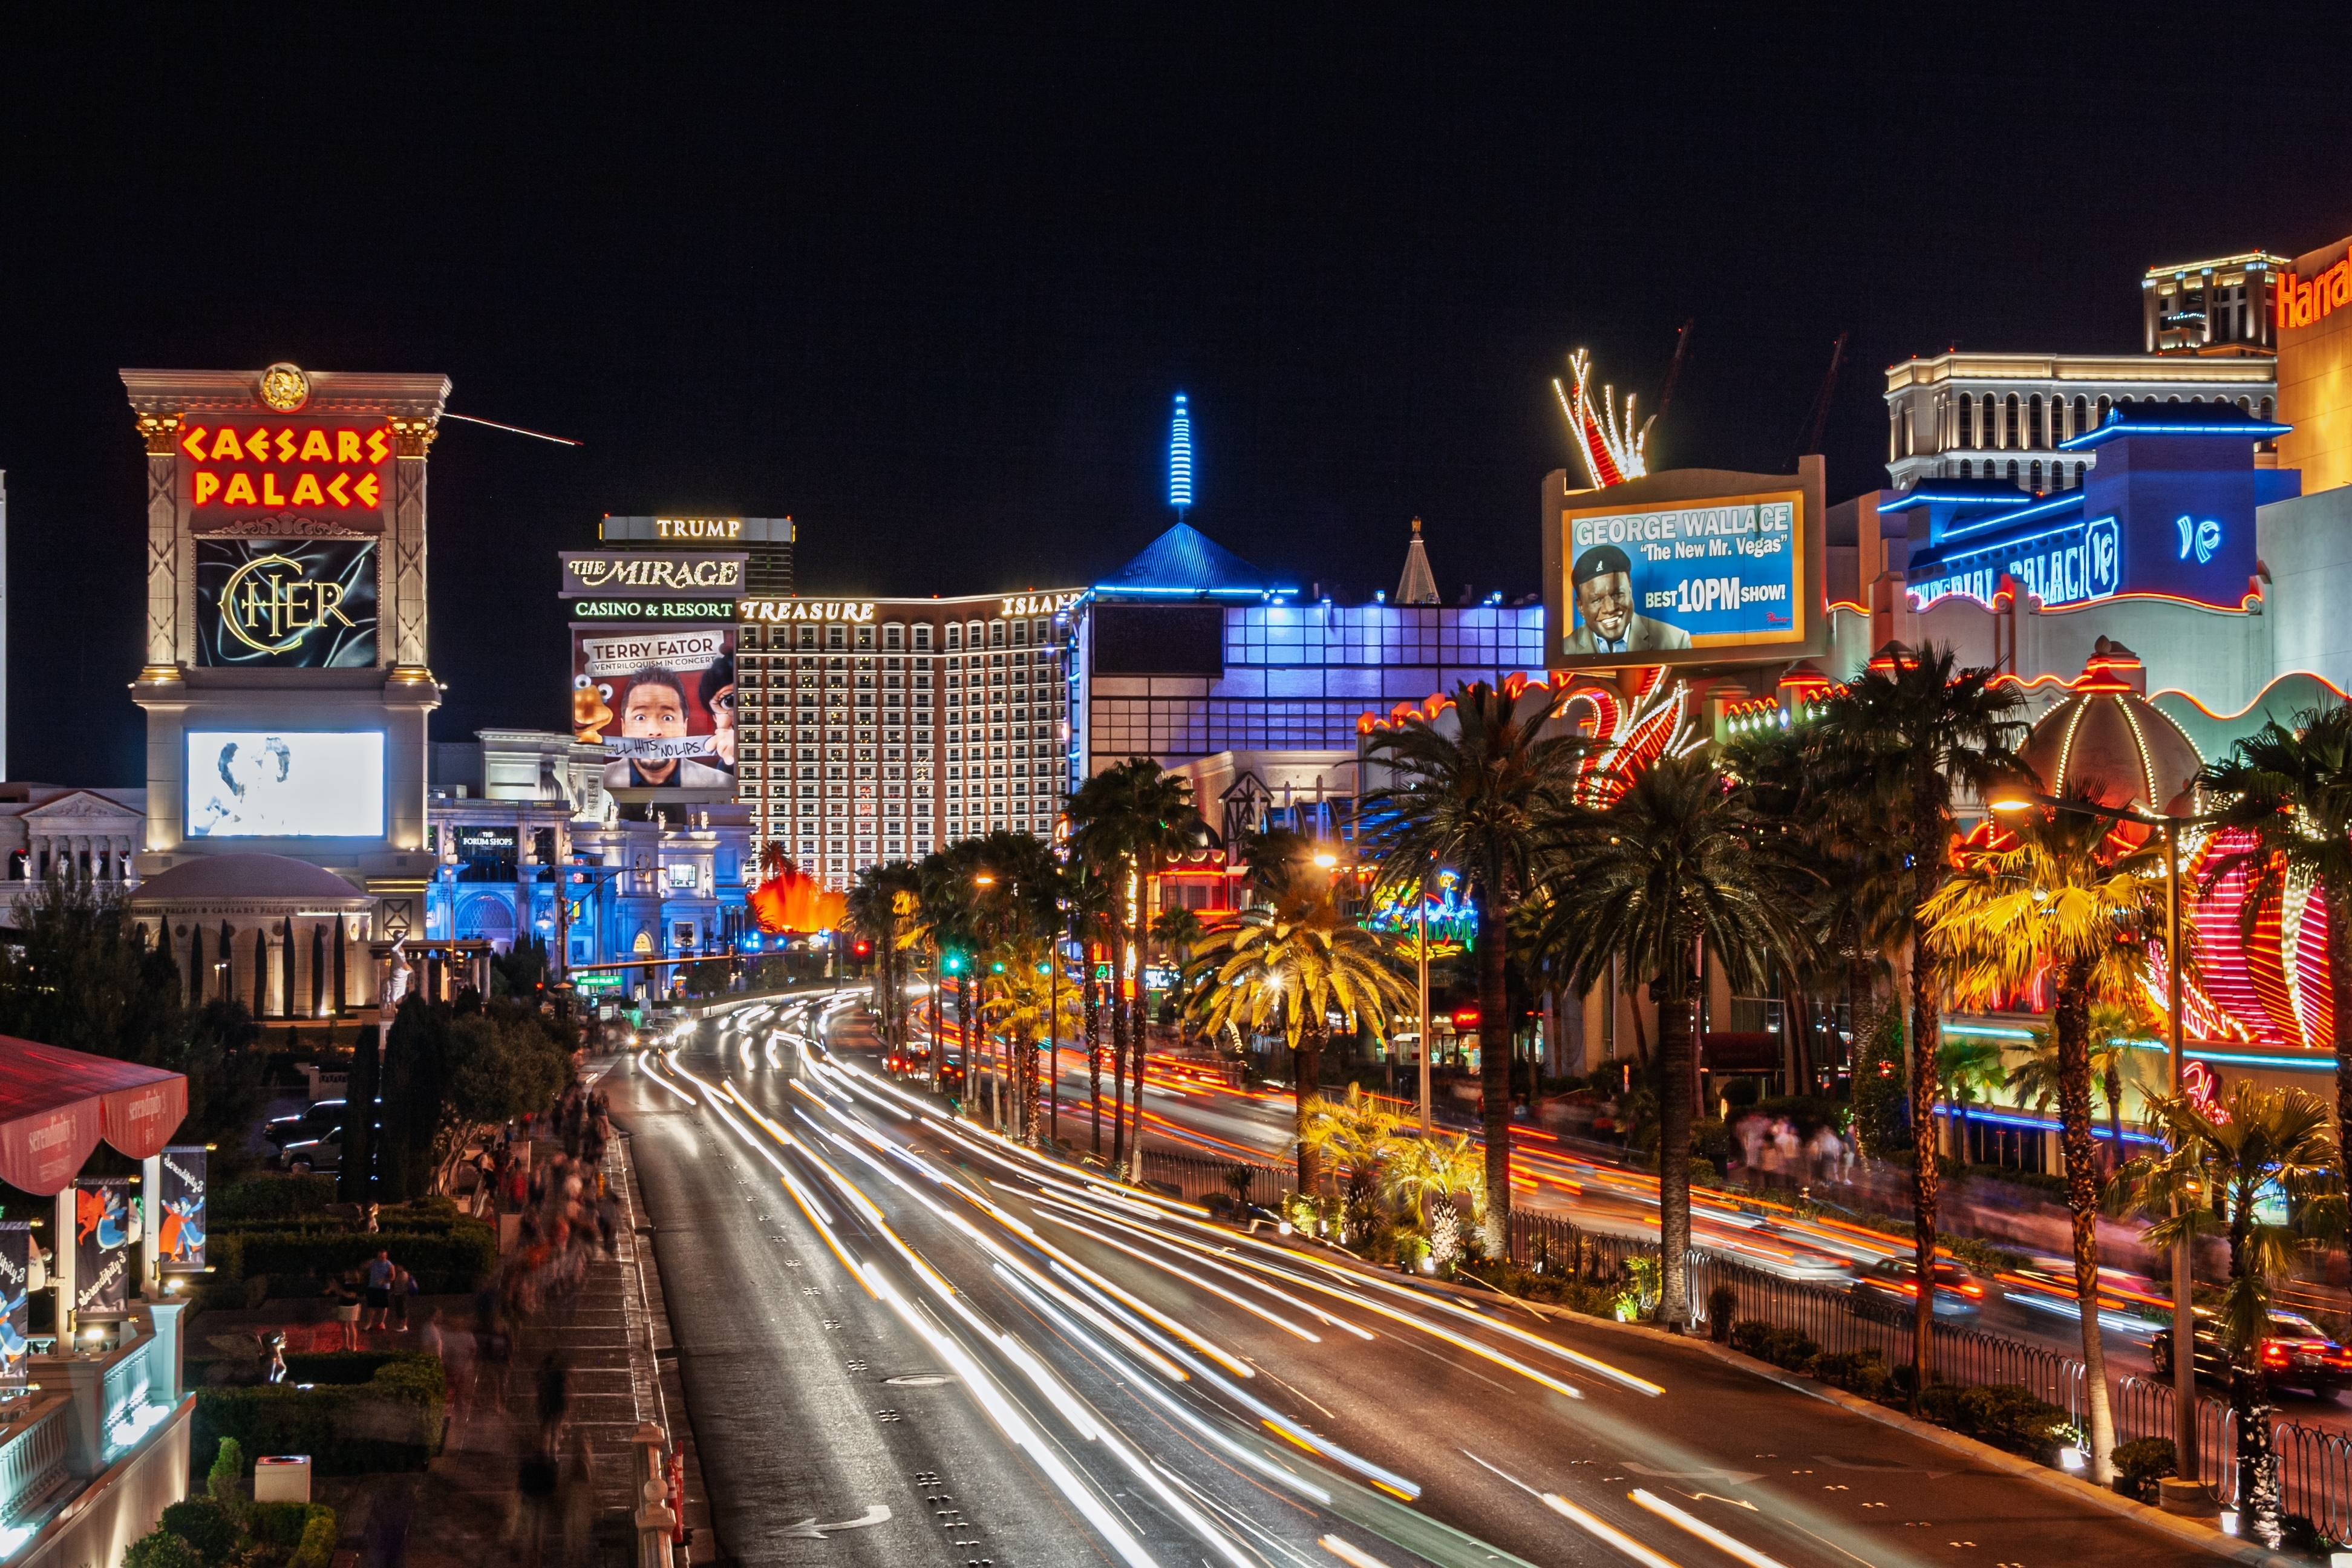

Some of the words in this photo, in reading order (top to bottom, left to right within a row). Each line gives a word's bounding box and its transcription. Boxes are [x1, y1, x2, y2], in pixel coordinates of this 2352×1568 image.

[183, 427, 388, 463] CAESARS
[195, 472, 380, 508] PALACE
[657, 520, 740, 538] TRUMP
[1576, 515, 1676, 546] GEORGE
[1684, 506, 1788, 537] WALLACE
[1675, 540, 1704, 558] New
[1708, 539, 1732, 557] Mr.
[569, 560, 606, 575] THE
[583, 561, 739, 589] MIRAGE
[217, 554, 355, 655] CHER
[1645, 590, 1677, 609] BEST
[1677, 577, 1740, 613] 10PM
[1741, 584, 1785, 603] SHOW!
[575, 603, 641, 617] CASINO
[645, 604, 659, 616] &
[662, 603, 733, 618] RESORT
[740, 601, 875, 622] TREASURE
[593, 642, 652, 659] TERRY
[658, 639, 714, 656] FATOR
[595, 659, 663, 671] VENTRILOQUISM
[675, 656, 716, 666] CONCERT
[635, 739, 660, 754] HITS.
[661, 745, 673, 757] NO
[675, 742, 703, 755] LIPS.
[117, 1251, 126, 1264] 3
